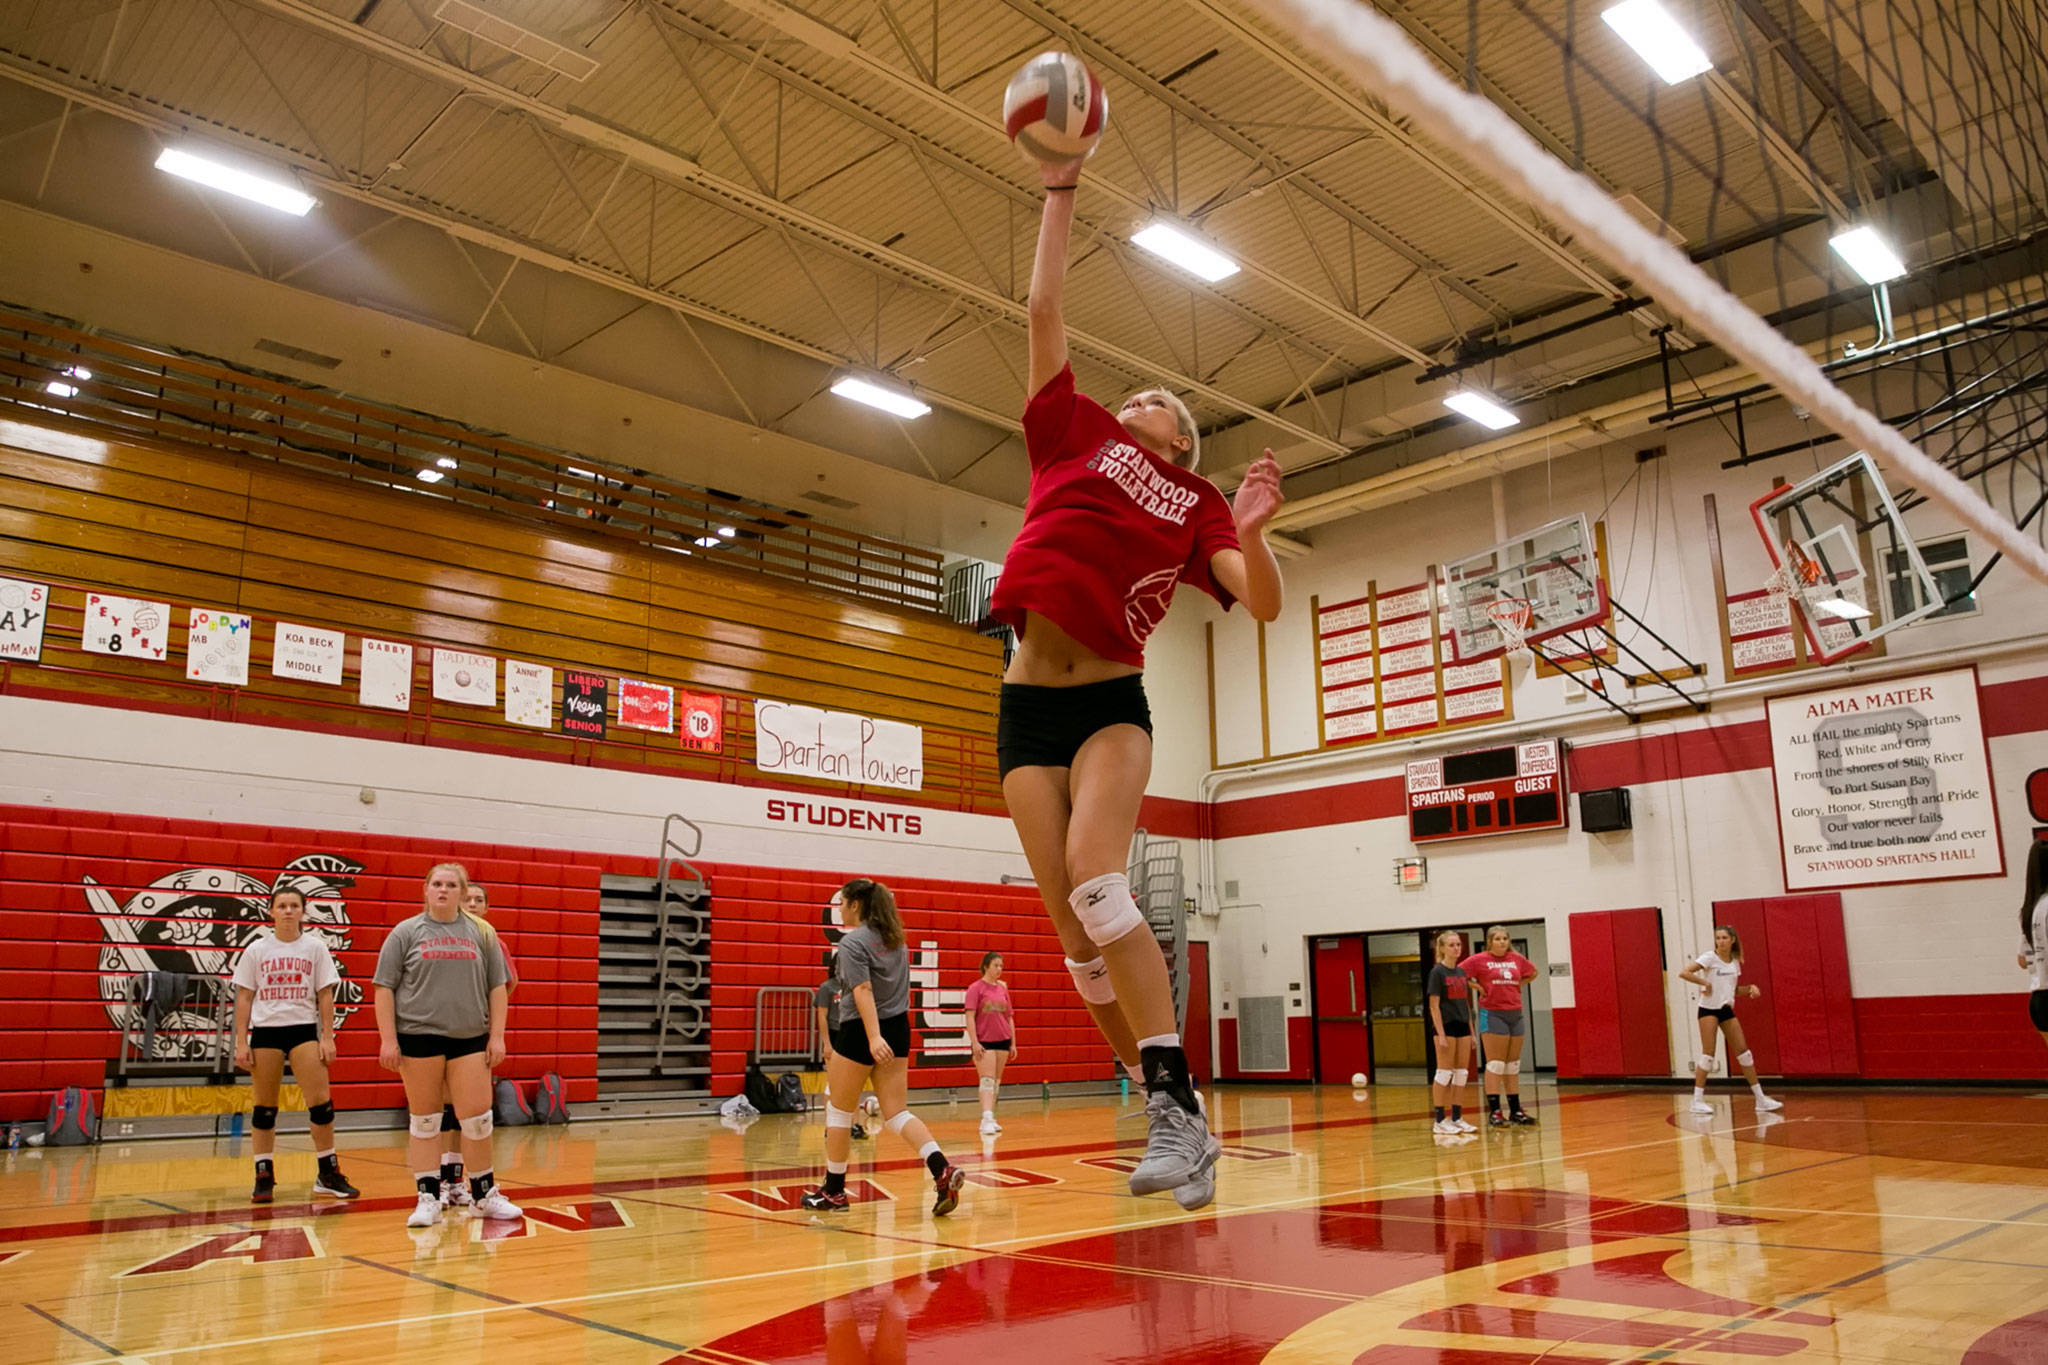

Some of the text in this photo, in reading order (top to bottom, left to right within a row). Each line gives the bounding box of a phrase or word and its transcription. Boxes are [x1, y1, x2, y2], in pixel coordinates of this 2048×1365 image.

[1108, 442, 1199, 508] STANWOOD
[1097, 455, 1186, 526] VOLLEYBALL
[1763, 602, 1788, 612] FAMILY
[190, 613, 250, 634] JORDYN
[191, 634, 208, 644] MB
[285, 633, 334, 648] KOA BECK
[367, 641, 406, 654] GABBY
[1754, 633, 1793, 646] CAMERON
[1740, 648, 1752, 658] JET
[1754, 645, 1770, 655] SET
[285, 660, 323, 673] MIDDLE
[568, 673, 605, 688] LIBERO
[1806, 686, 1934, 718] ALMA MATER
[564, 718, 602, 733] SENIOR
[1789, 713, 1961, 745] ALL HAIL the mighty Spartans
[759, 704, 921, 785] Spartan Power
[1845, 743, 1878, 756] White
[1880, 741, 1902, 752] and
[1905, 737, 1932, 751] Gray
[1793, 751, 1965, 781] From the shores of Stilly River
[1412, 776, 1552, 807] SPARTANS PERIOD GUEST
[1827, 775, 1932, 796] To Port Susan Bay
[1791, 788, 1980, 820] Glory, Honor, Strength and Pride
[766, 799, 922, 836] STUDENTS
[1827, 811, 1944, 834] Our valor never fails
[1793, 828, 1987, 856] Brave and true both now and ever
[1807, 848, 1976, 873] STANWOOD SPARTANS HAIL!
[261, 957, 313, 976] STANWOOD
[260, 986, 308, 1001] ATHLETICS
